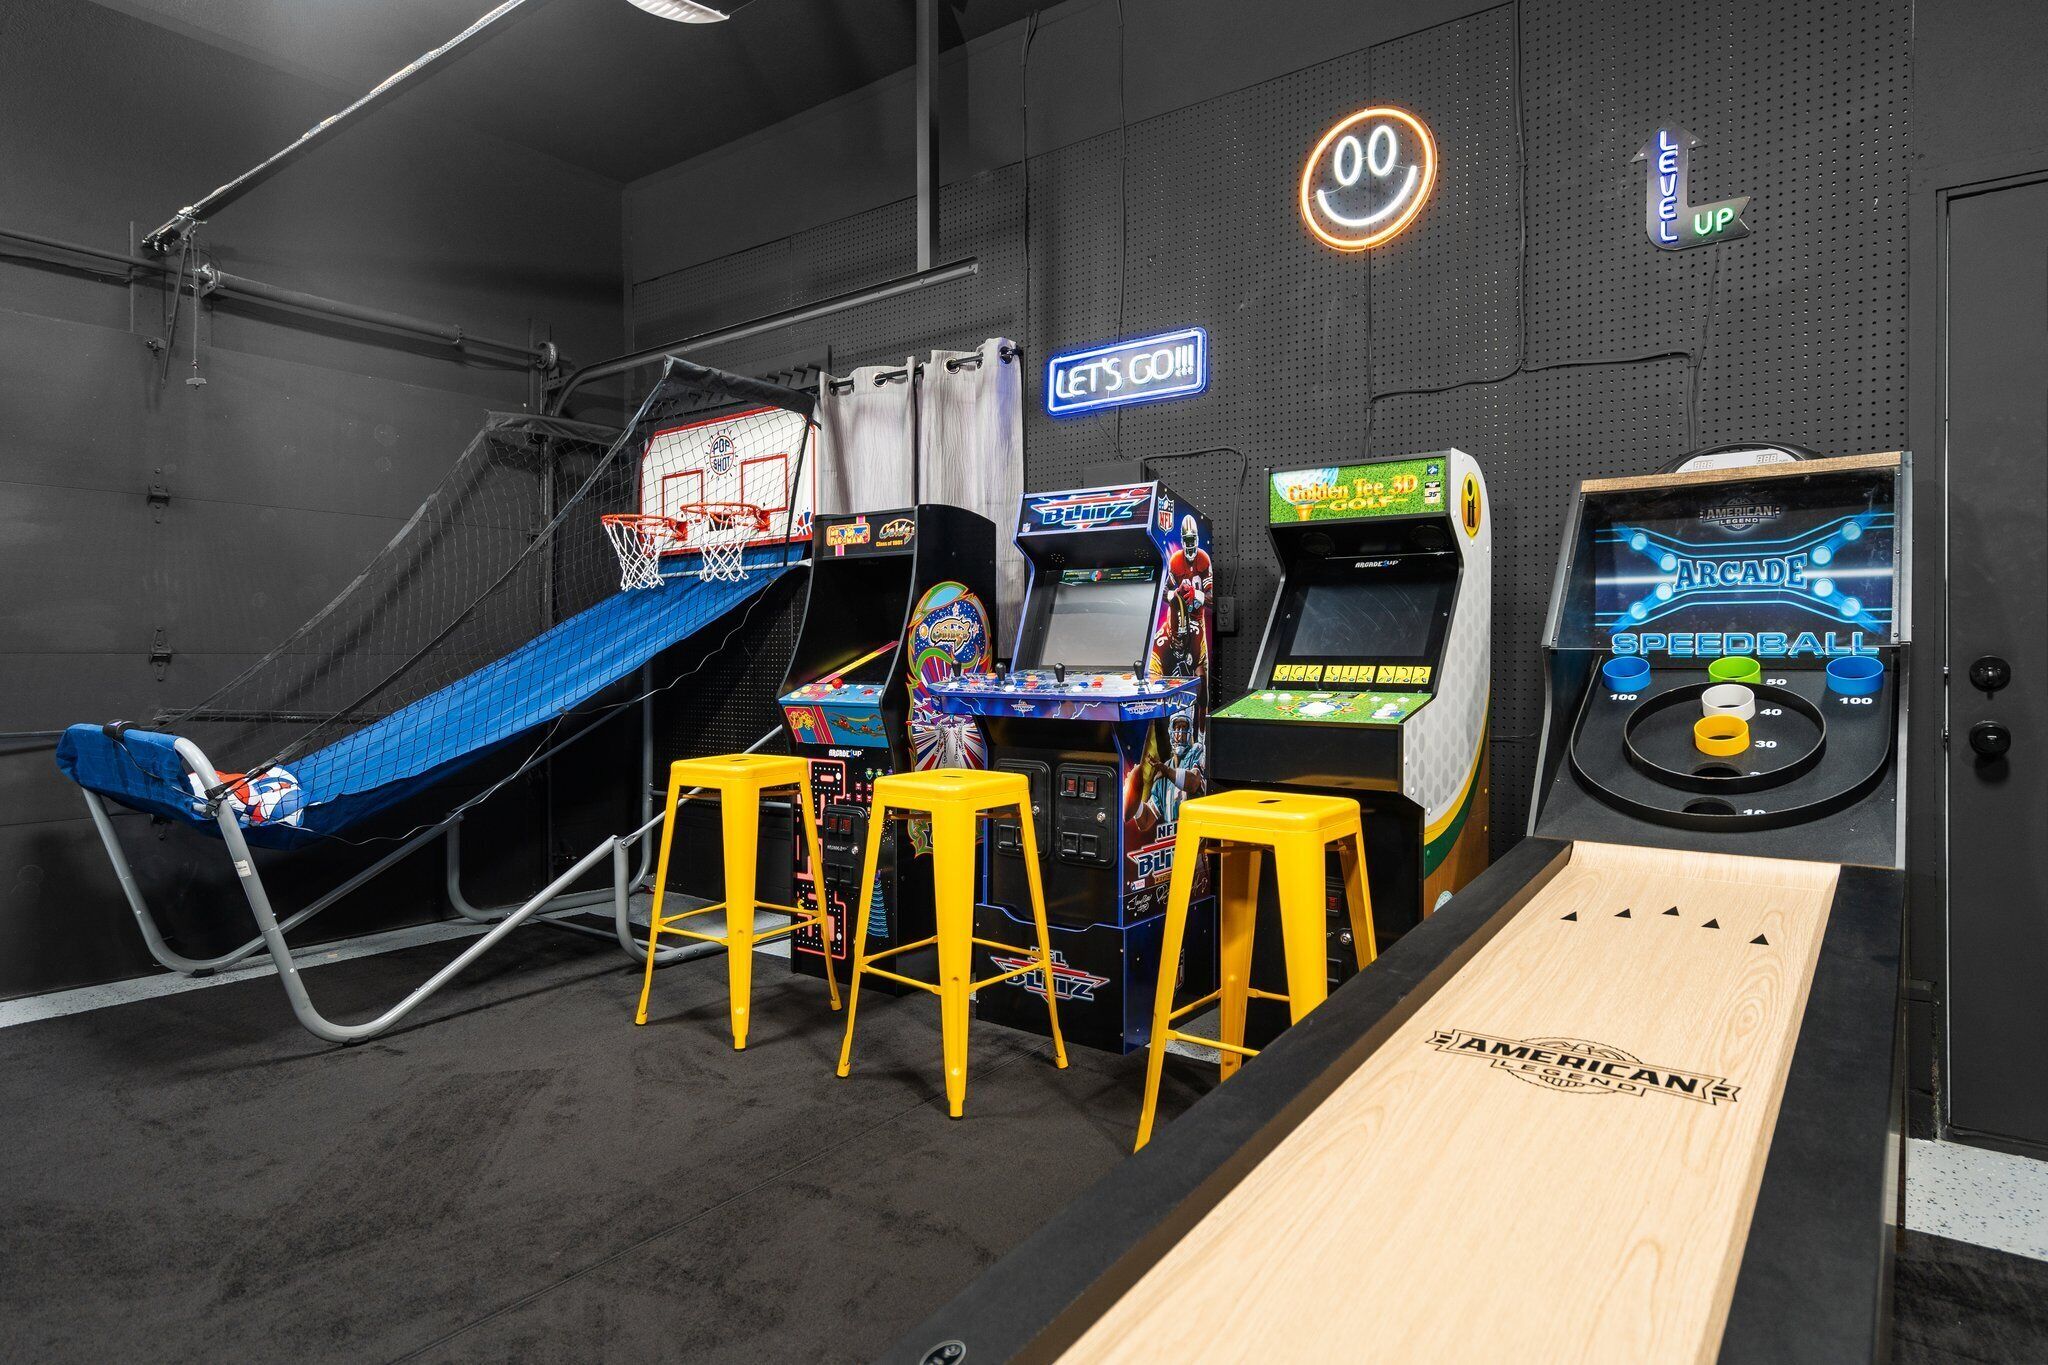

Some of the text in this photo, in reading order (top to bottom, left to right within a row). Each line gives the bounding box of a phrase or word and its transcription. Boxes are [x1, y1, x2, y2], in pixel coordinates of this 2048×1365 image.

[1658, 130, 1679, 241] LEVEL
[1694, 207, 1734, 235] UP
[1056, 344, 1194, 398] LET'S GO!!!
[712, 438, 731, 454] POP
[712, 456, 731, 472] SHOT
[1287, 474, 1419, 502] Golden Tee 3D
[1329, 496, 1394, 511] GOLF
[1706, 505, 1773, 519] AMERICAN
[1159, 511, 1172, 530] NFL
[1720, 517, 1759, 525] LEGEND
[1674, 553, 1808, 592] ARCADE
[1611, 632, 1879, 657] SPEEDBALL
[1766, 678, 1787, 686] 50
[1839, 697, 1872, 705] 100
[1755, 740, 1777, 748] 30
[1459, 1037, 1698, 1093] AMERICAN
[1501, 1061, 1637, 1092] LEGEND
